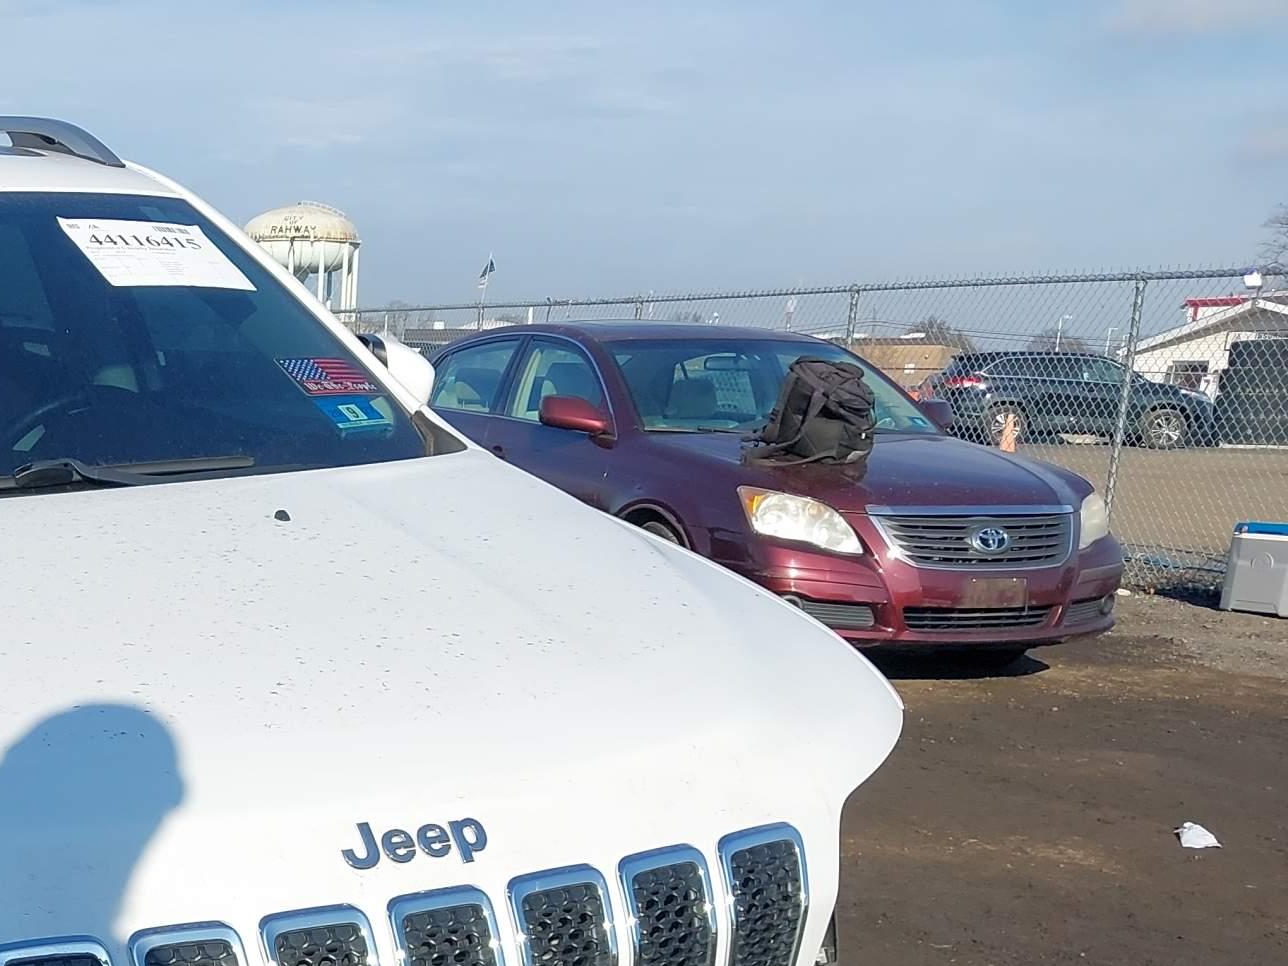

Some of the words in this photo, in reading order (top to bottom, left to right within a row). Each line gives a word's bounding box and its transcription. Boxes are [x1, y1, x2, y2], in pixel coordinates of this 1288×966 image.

[270, 225, 317, 234] RAHWAY
[89, 233, 202, 250] 44116415
[341, 817, 488, 870] Jeep
